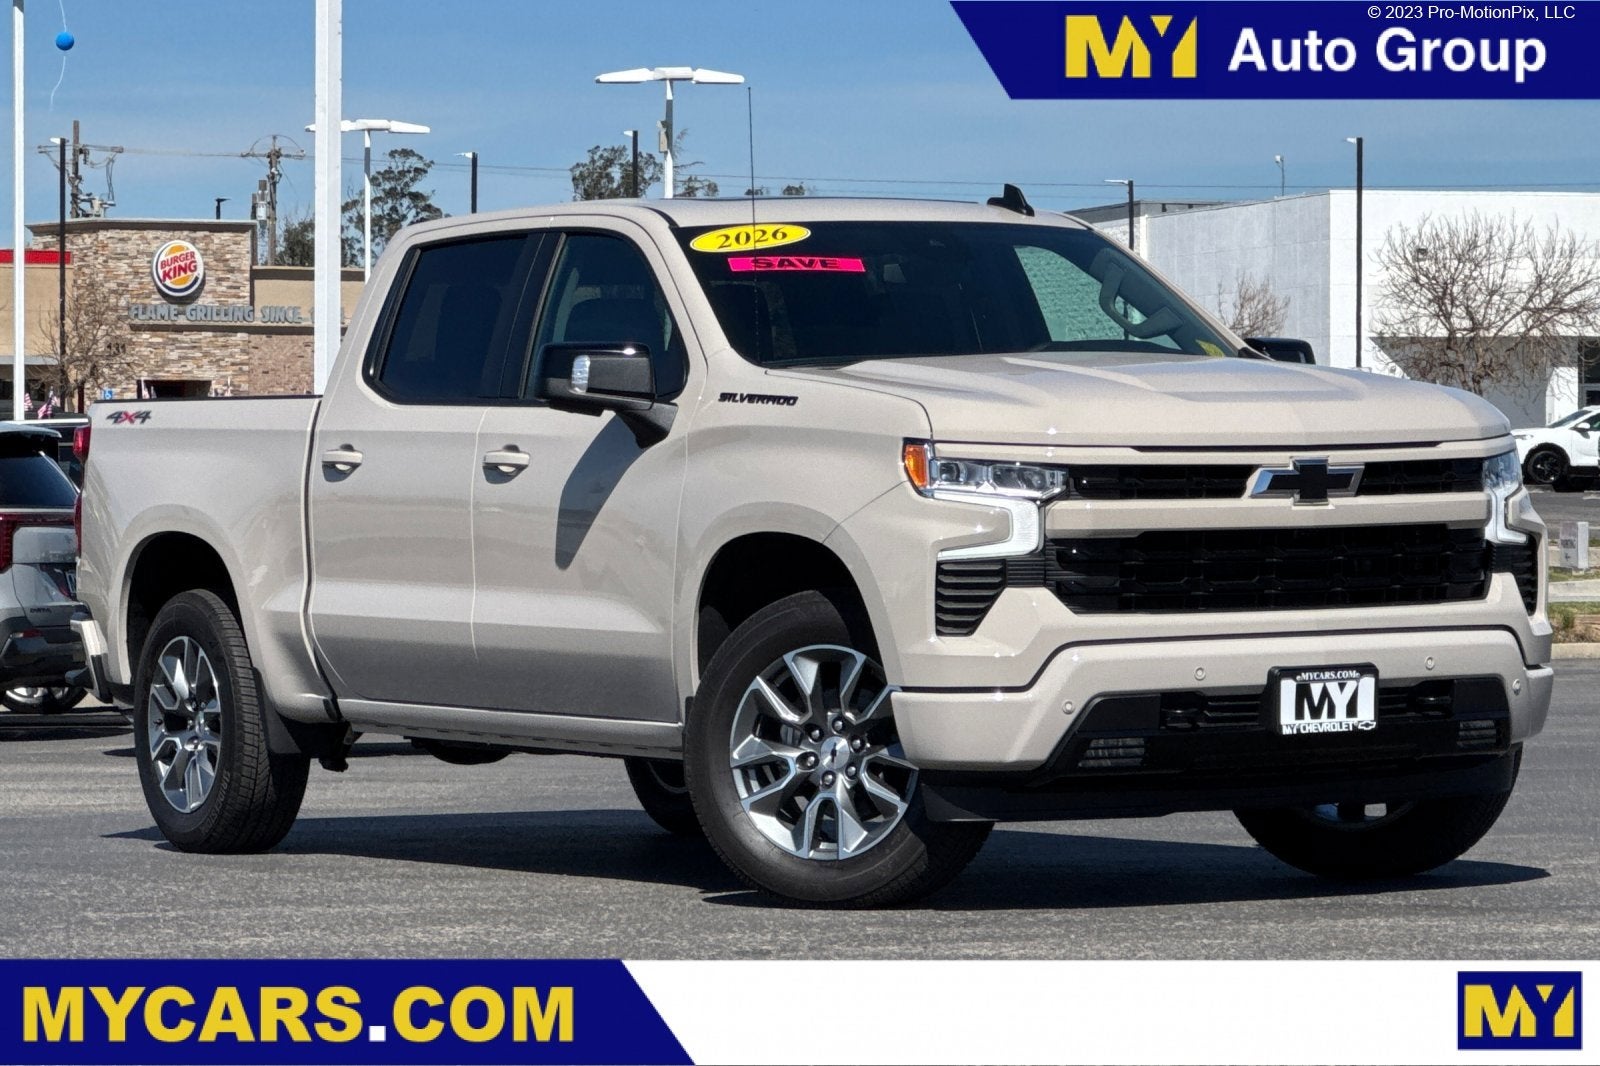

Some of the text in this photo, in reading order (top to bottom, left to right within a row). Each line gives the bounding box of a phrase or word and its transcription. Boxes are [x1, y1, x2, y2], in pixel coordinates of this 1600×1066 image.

[716, 227, 789, 249] 2026
[160, 251, 196, 270] BURGER
[751, 258, 840, 269] SAVE
[162, 260, 198, 283] KING
[129, 303, 179, 321] FLAME
[185, 304, 254, 322] GRILLING
[260, 306, 302, 324] SINCE
[718, 392, 799, 406] SILVERADO
[1282, 721, 1354, 735] MY CHEVROLET
